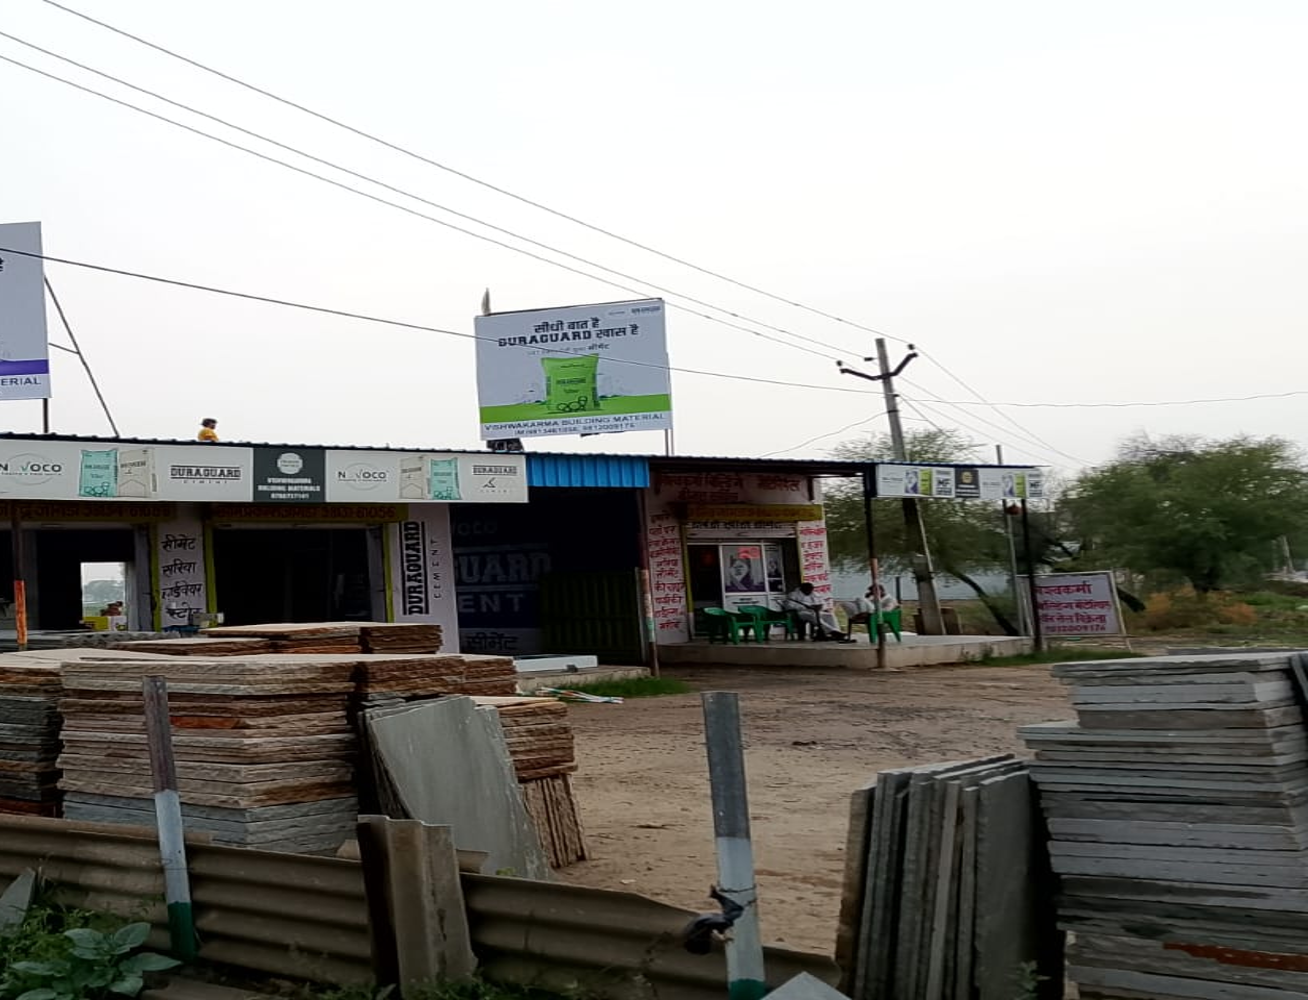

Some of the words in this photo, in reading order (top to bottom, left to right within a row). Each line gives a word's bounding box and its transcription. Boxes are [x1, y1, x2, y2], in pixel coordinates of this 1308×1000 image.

[498, 331, 592, 347] DURAGUARD
[170, 464, 241, 480] DURAGUARD
[403, 521, 424, 615] DURAGUARD
[430, 538, 443, 600] CEMENT
